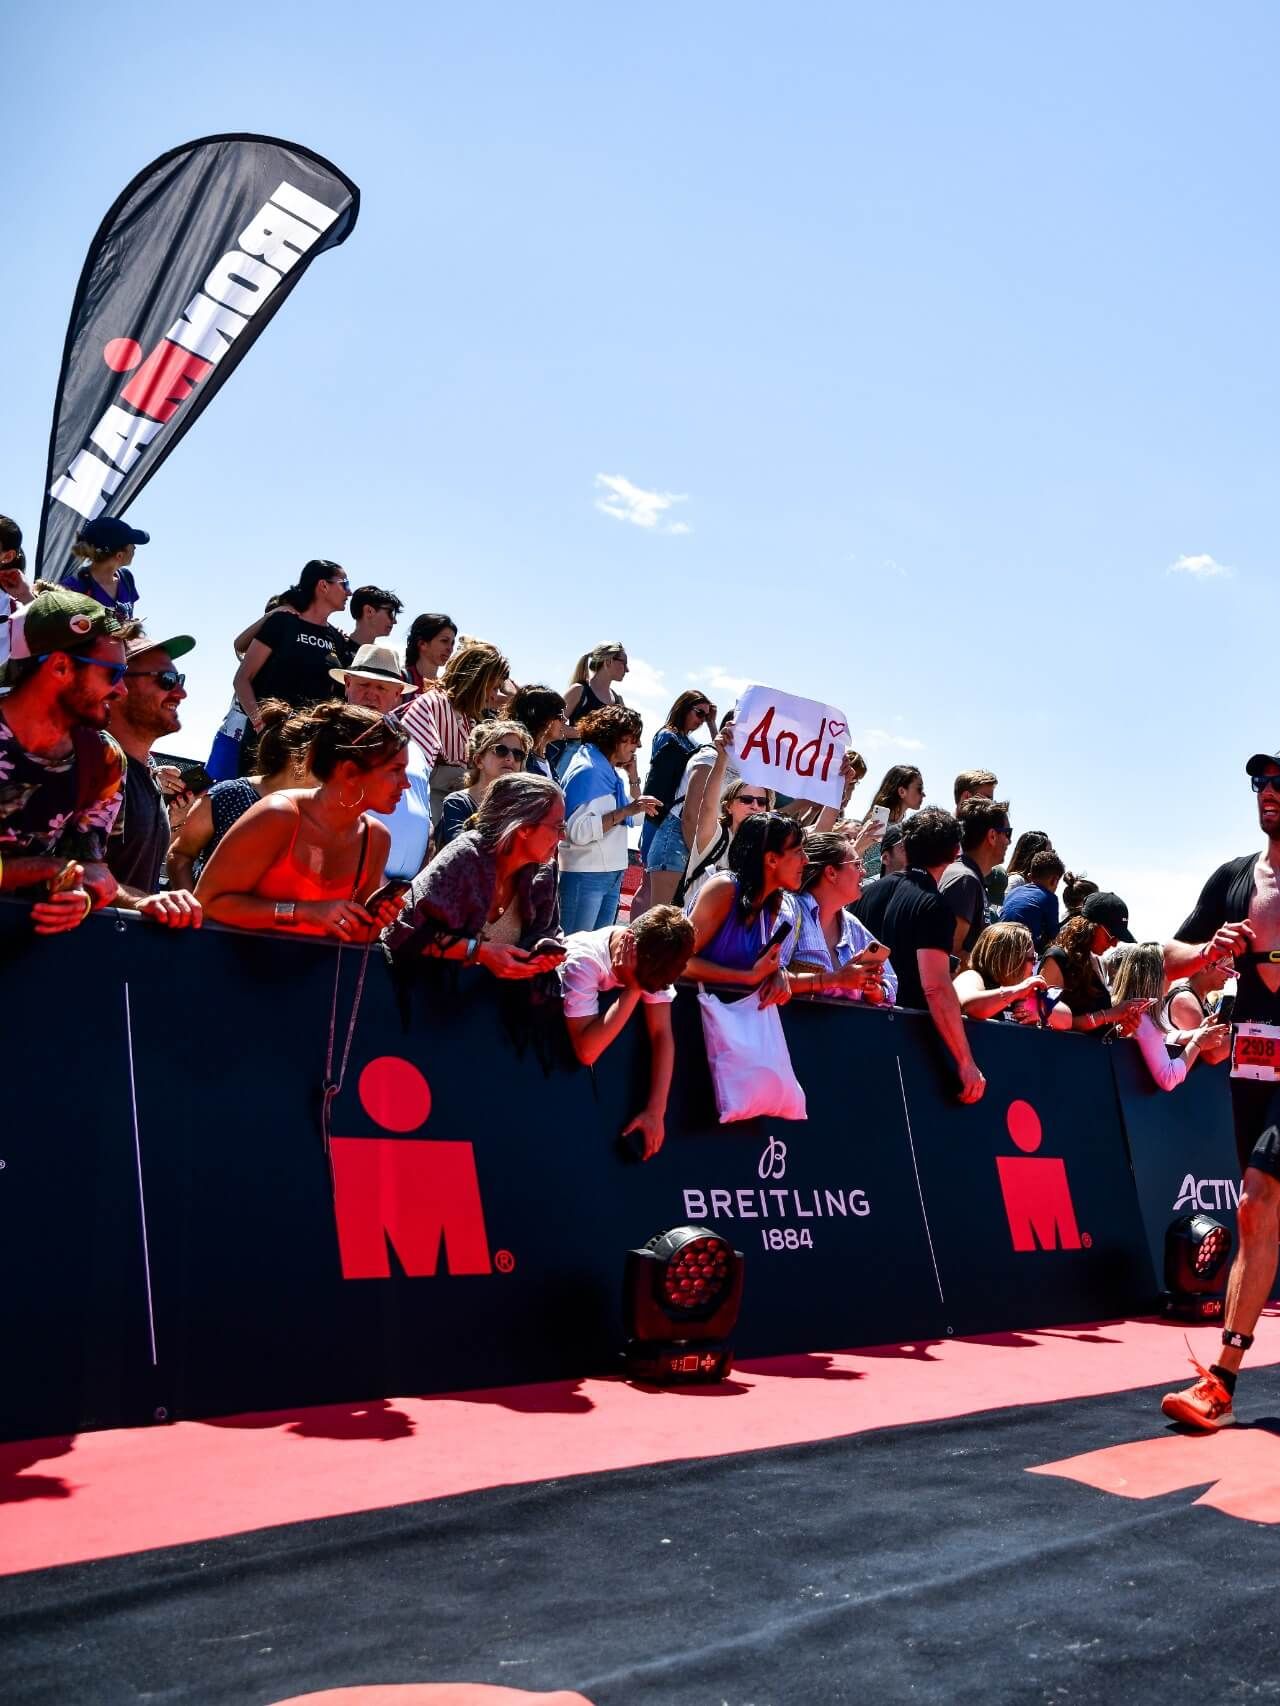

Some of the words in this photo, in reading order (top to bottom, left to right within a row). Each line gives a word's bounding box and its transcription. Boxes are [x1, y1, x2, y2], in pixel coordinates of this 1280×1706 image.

[741, 706, 834, 781] Andi
[683, 1189, 871, 1218] BREITLING
[762, 1228, 814, 1250] 1884
